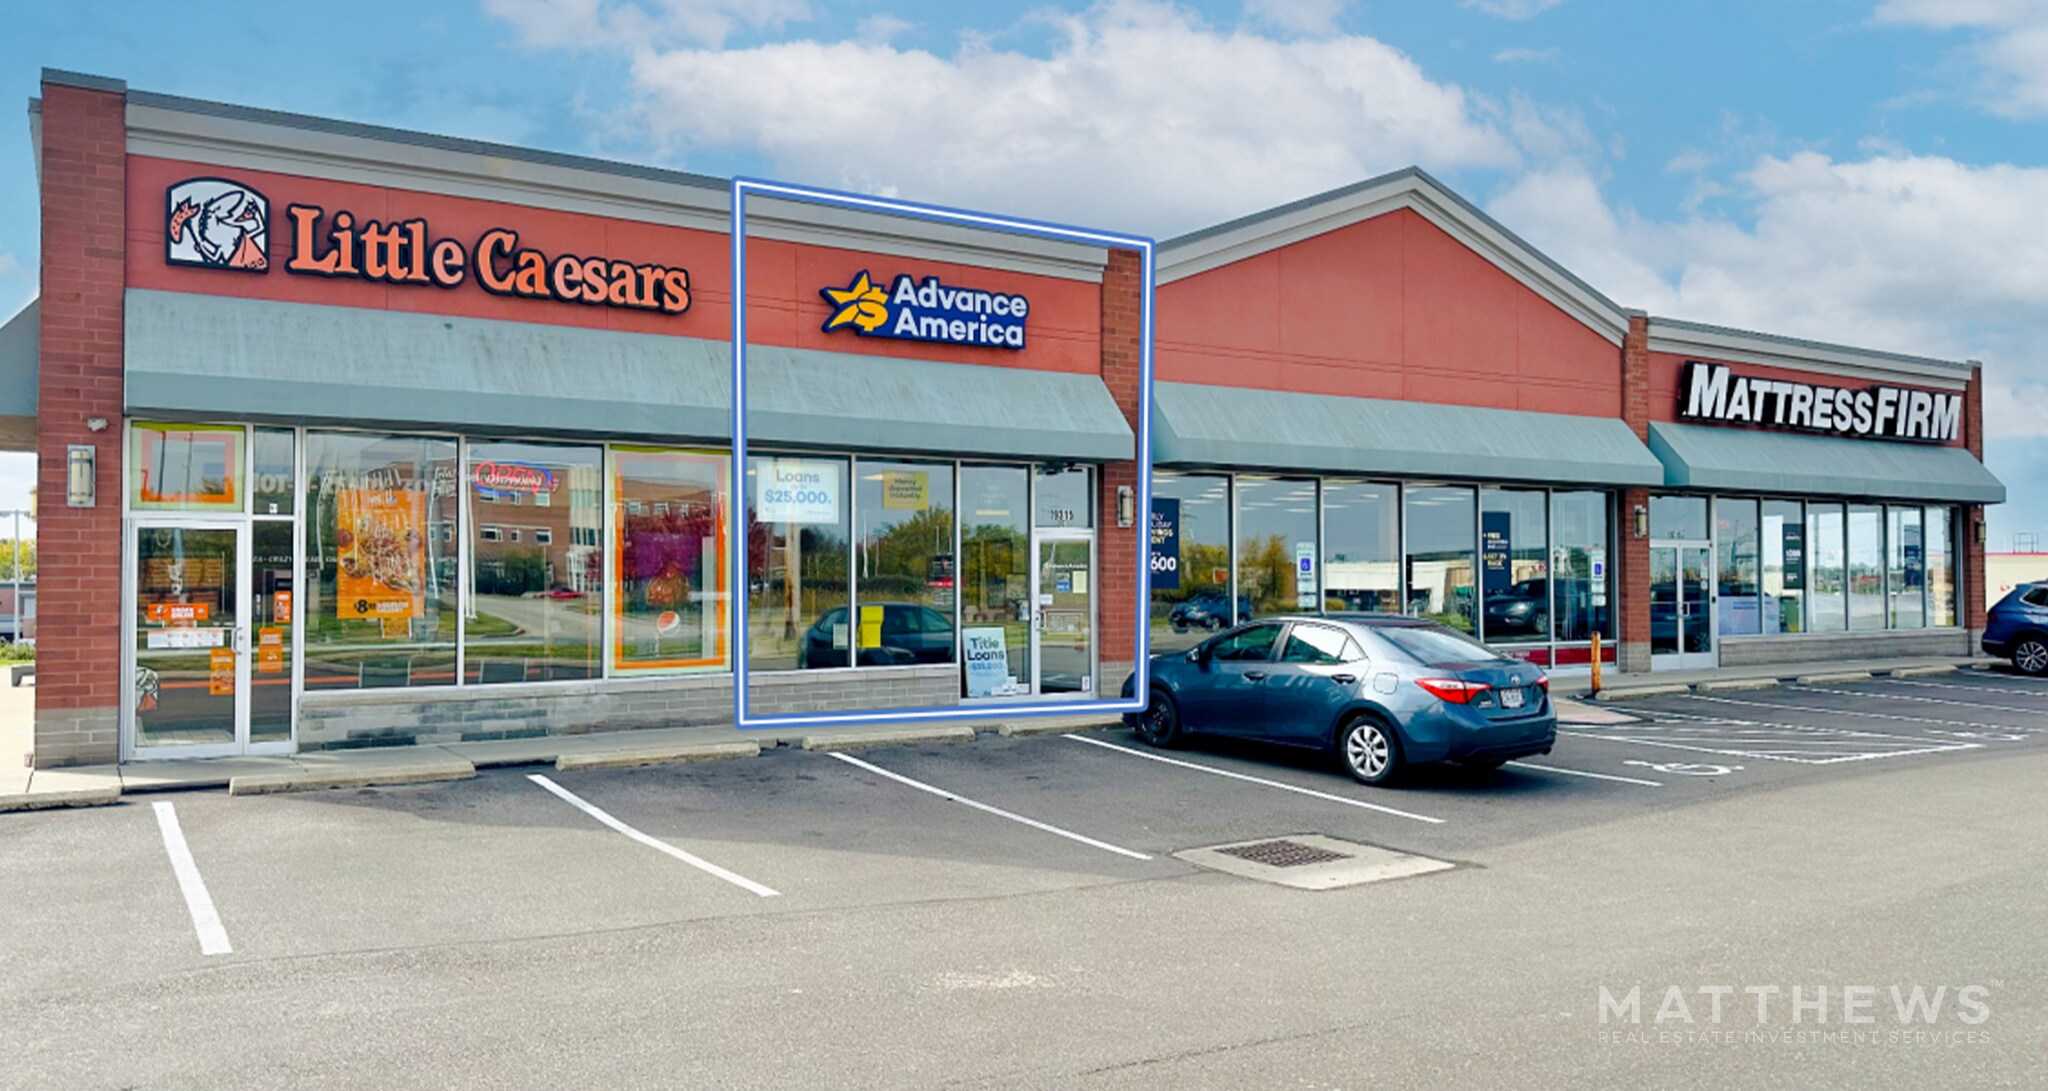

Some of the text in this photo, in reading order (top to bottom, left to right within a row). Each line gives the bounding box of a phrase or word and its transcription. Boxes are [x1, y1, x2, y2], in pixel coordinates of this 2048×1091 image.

[288, 205, 689, 312] Little Caesars
[893, 277, 1027, 317] Advance
[893, 308, 1024, 346] America
[776, 469, 820, 484] Loans
[967, 649, 1005, 661] Loans
[969, 636, 999, 650] Title
